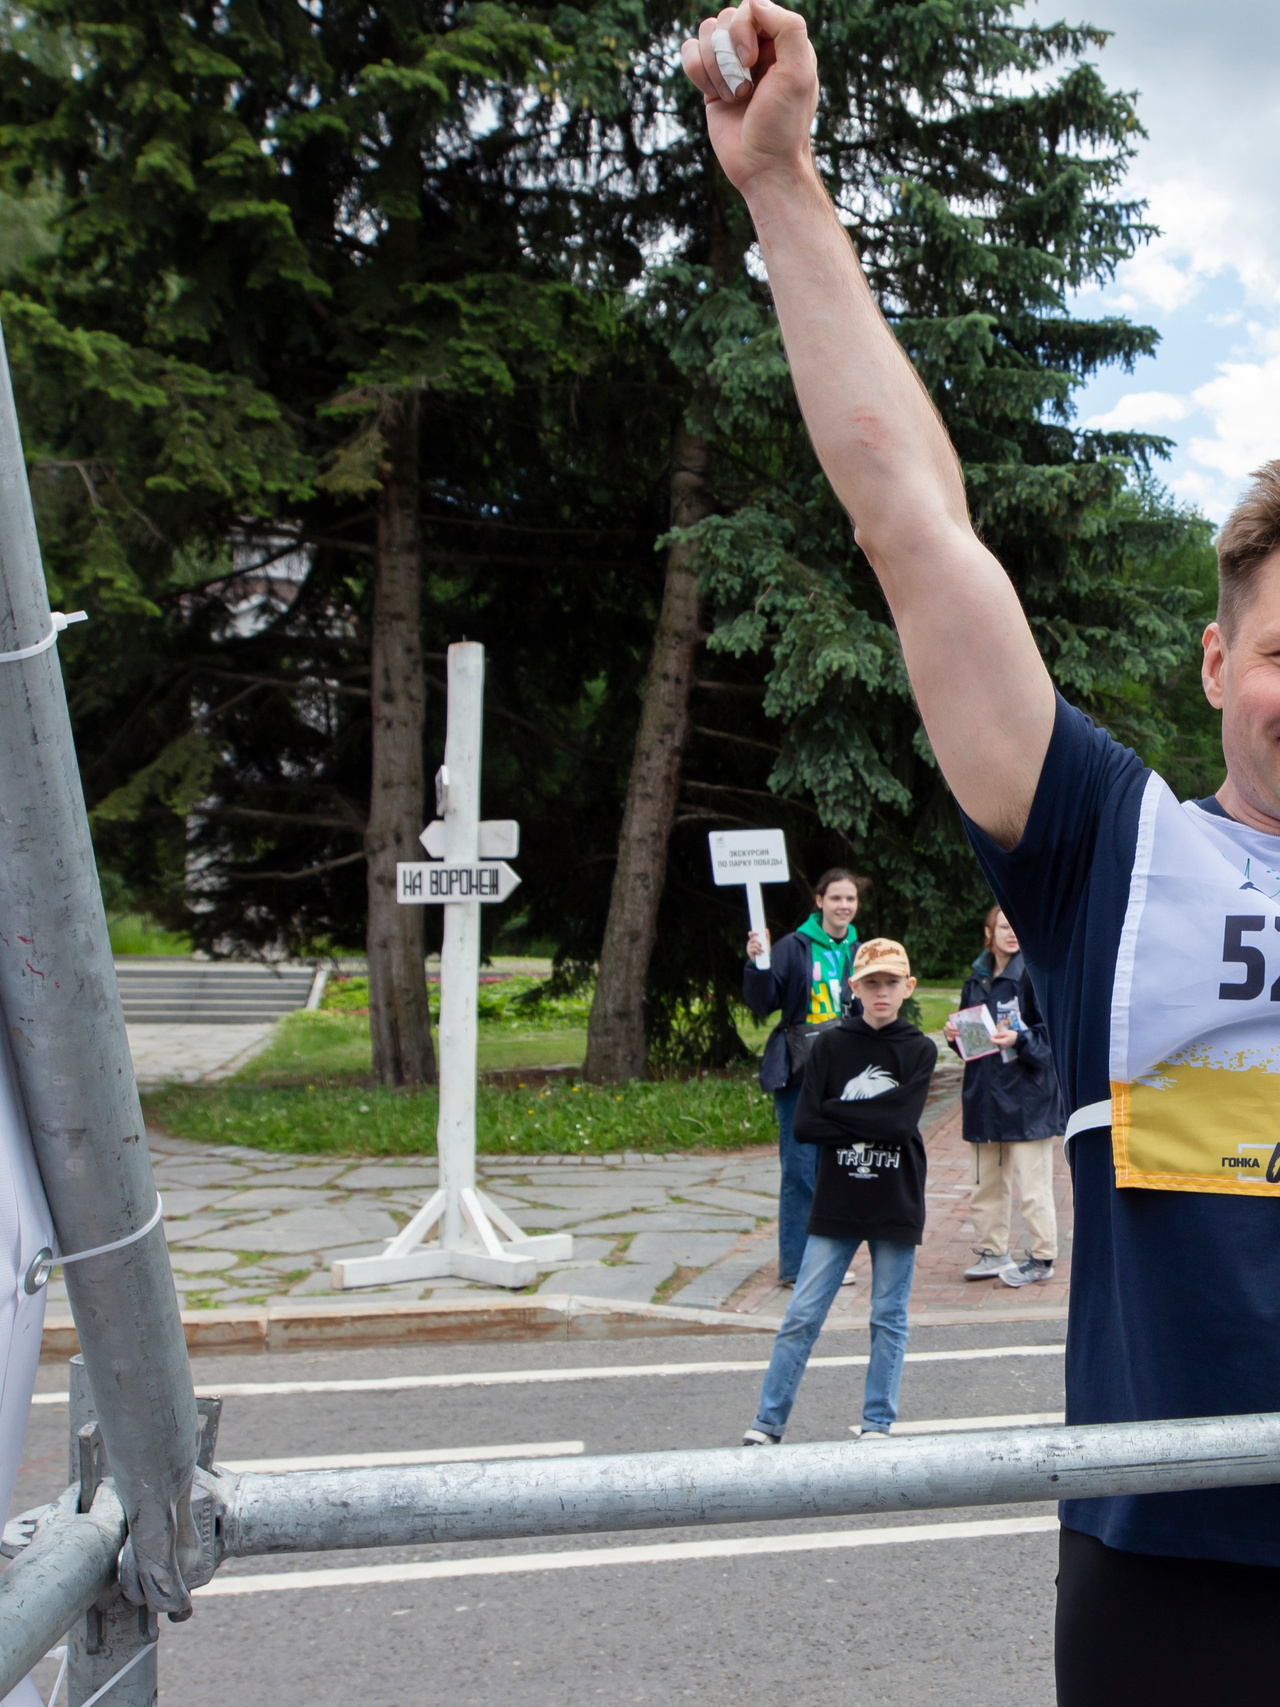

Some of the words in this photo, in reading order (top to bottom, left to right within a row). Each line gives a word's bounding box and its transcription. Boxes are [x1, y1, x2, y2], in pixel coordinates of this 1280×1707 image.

[729, 849, 769, 857] ЭКСКУРСИЯ
[754, 858, 782, 866] ПОБЕДЫ
[402, 869, 422, 896] НА
[429, 868, 499, 896] ВОРОНЕЖ
[836, 1149, 901, 1169] TRUTH
[1221, 1157, 1260, 1169] ГОНКА
